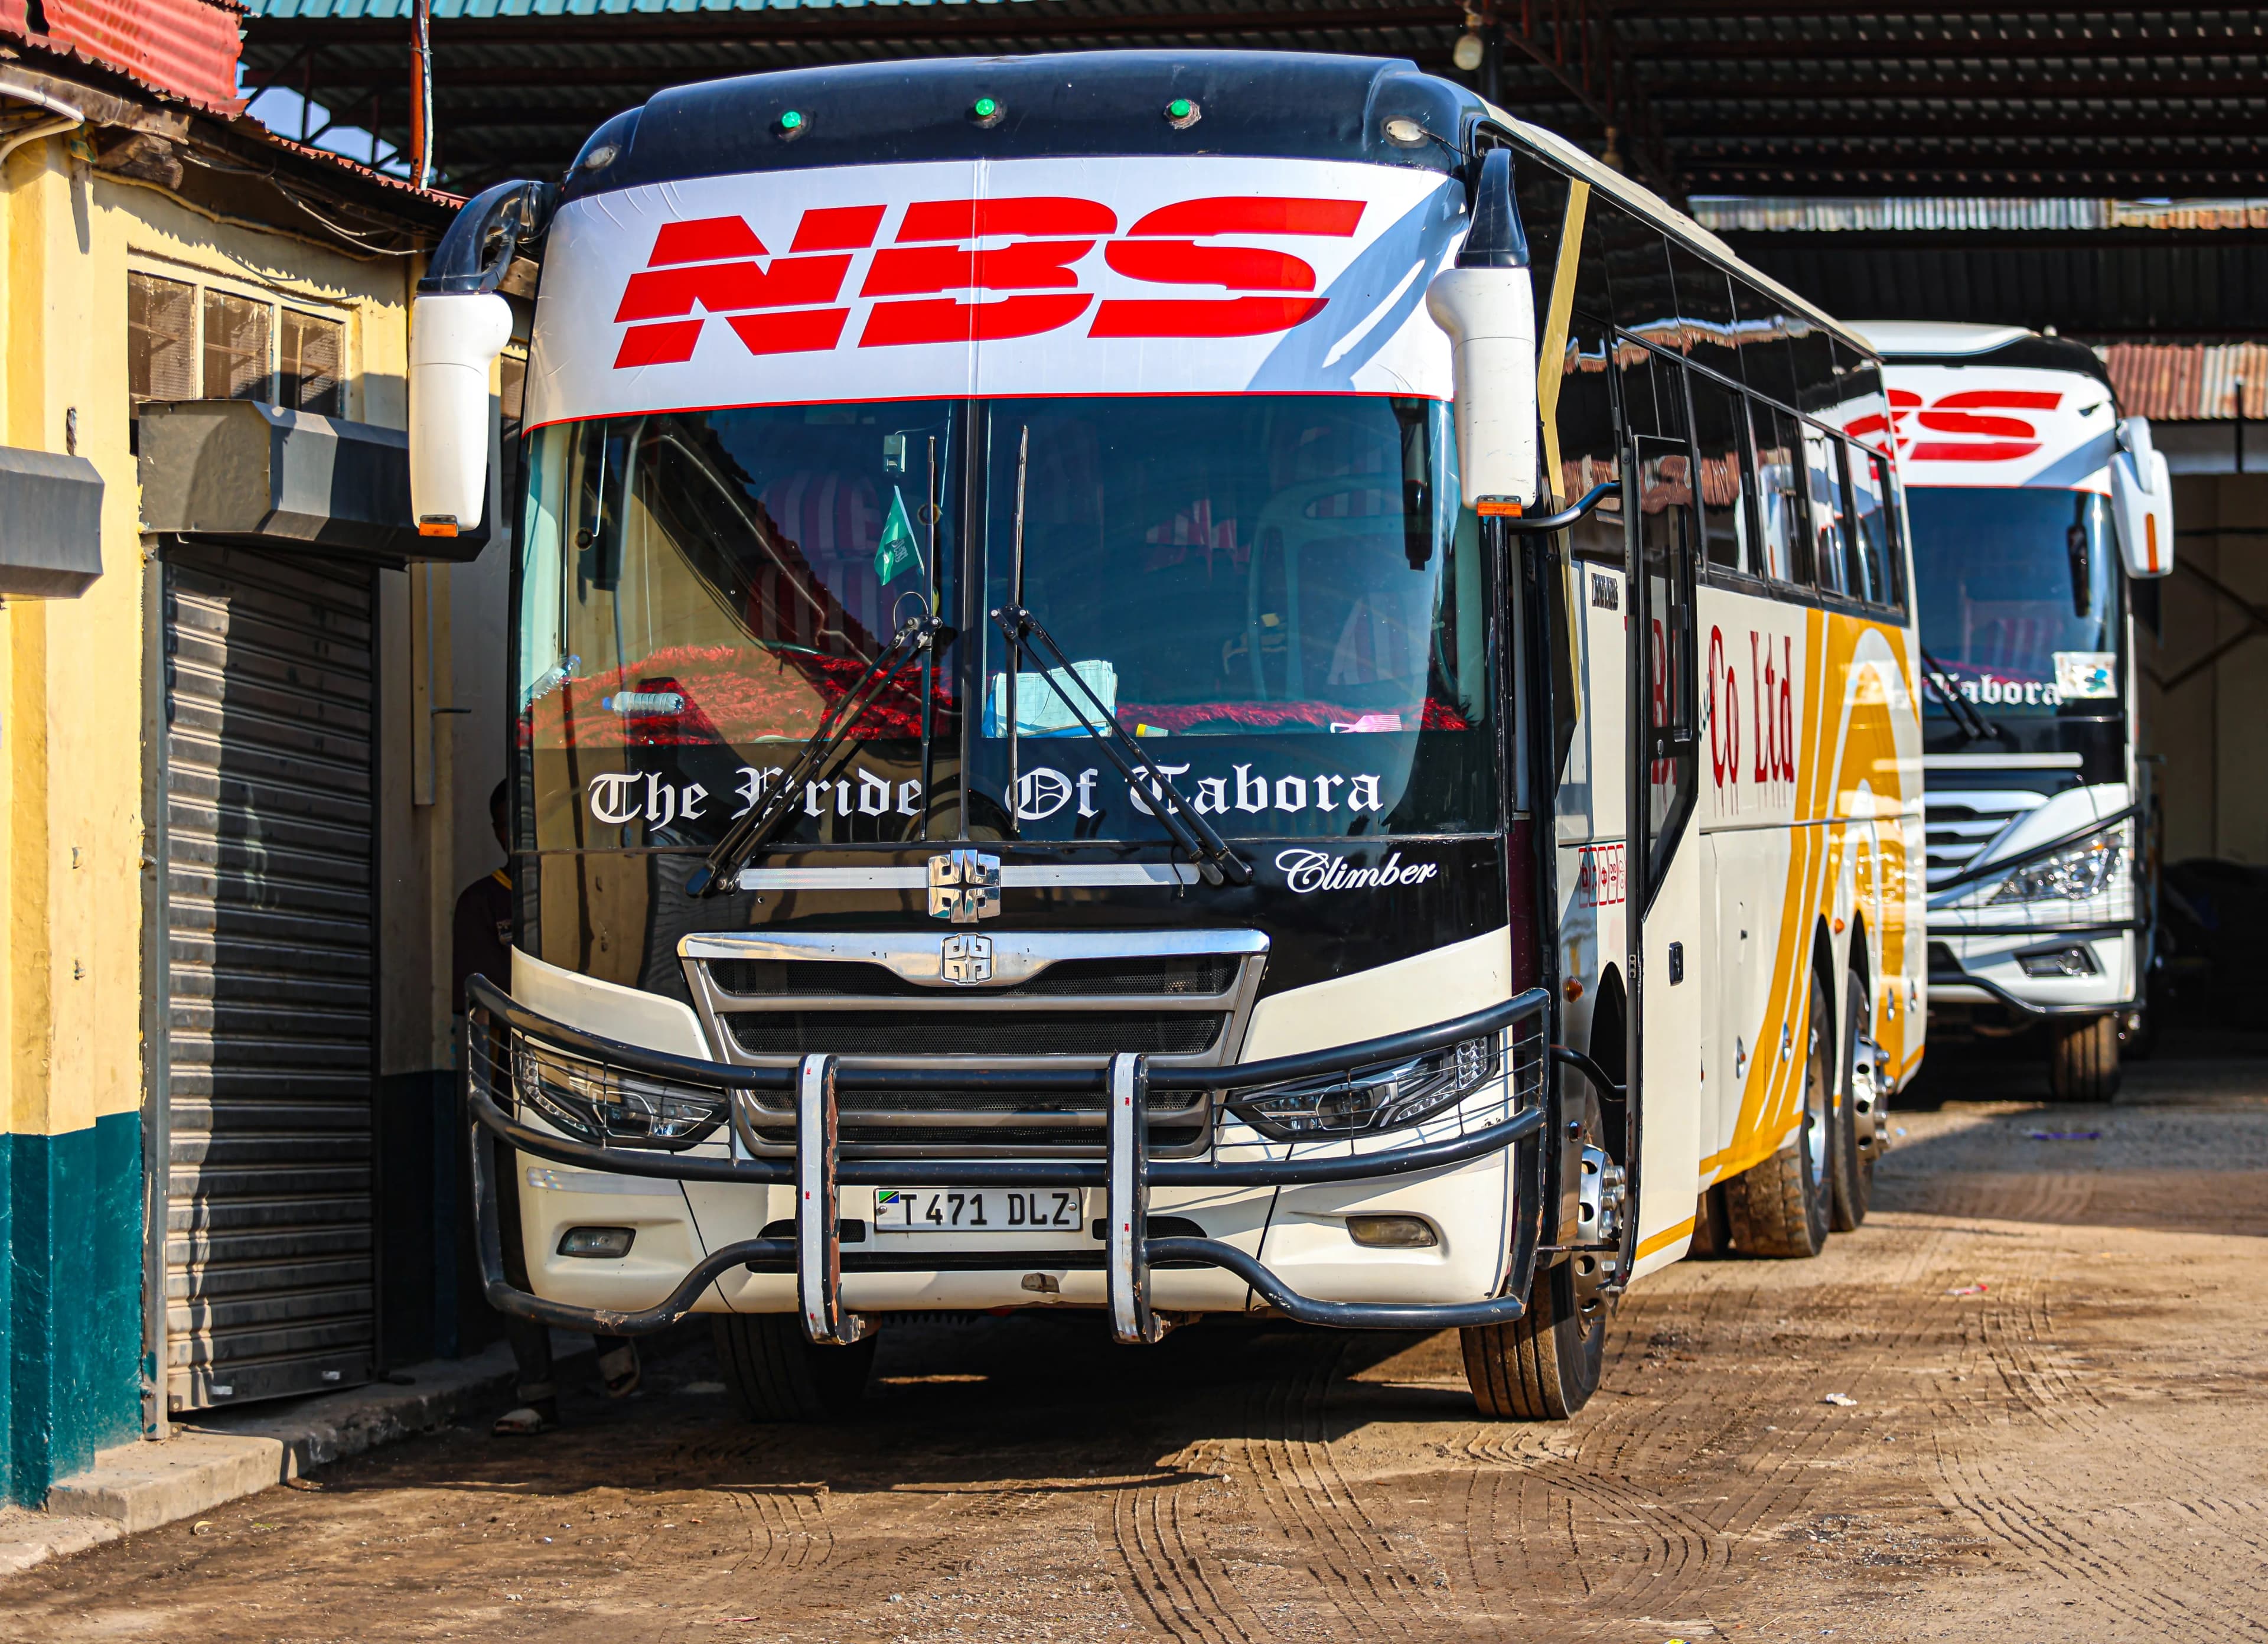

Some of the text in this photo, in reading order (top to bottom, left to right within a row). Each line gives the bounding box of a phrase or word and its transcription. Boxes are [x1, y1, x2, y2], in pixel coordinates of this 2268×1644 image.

[613, 196, 1367, 371] NBS
[1709, 624, 1739, 789] Co
[1750, 630, 1795, 784] Ltd
[588, 771, 709, 832] The
[1004, 767, 1099, 821] Of
[1130, 763, 1384, 816] Tabora
[1275, 848, 1438, 894] Climber
[900, 1193, 1071, 1226] T 471 DLZ
